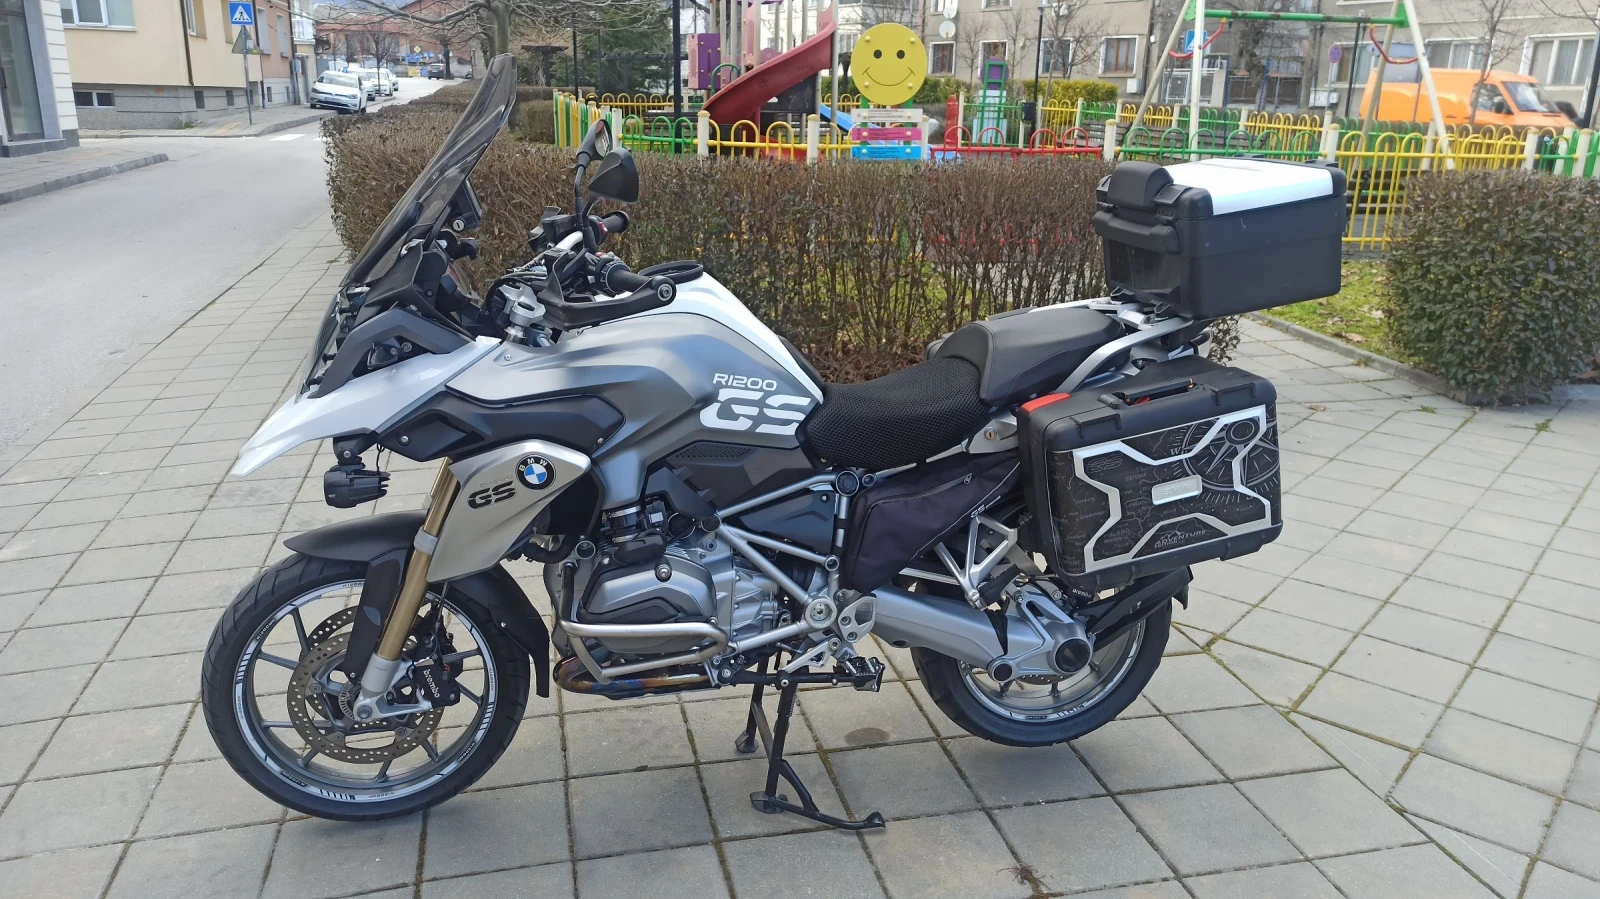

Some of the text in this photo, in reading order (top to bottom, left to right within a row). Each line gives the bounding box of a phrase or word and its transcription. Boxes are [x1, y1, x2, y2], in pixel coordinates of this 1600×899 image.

[712, 373, 778, 391] R1200
[699, 388, 811, 435] GS
[518, 457, 548, 472] BMW
[467, 480, 518, 510] GS
[970, 503, 986, 519] GS
[1154, 529, 1207, 546] ADVENTURE
[422, 668, 441, 699] brembo
